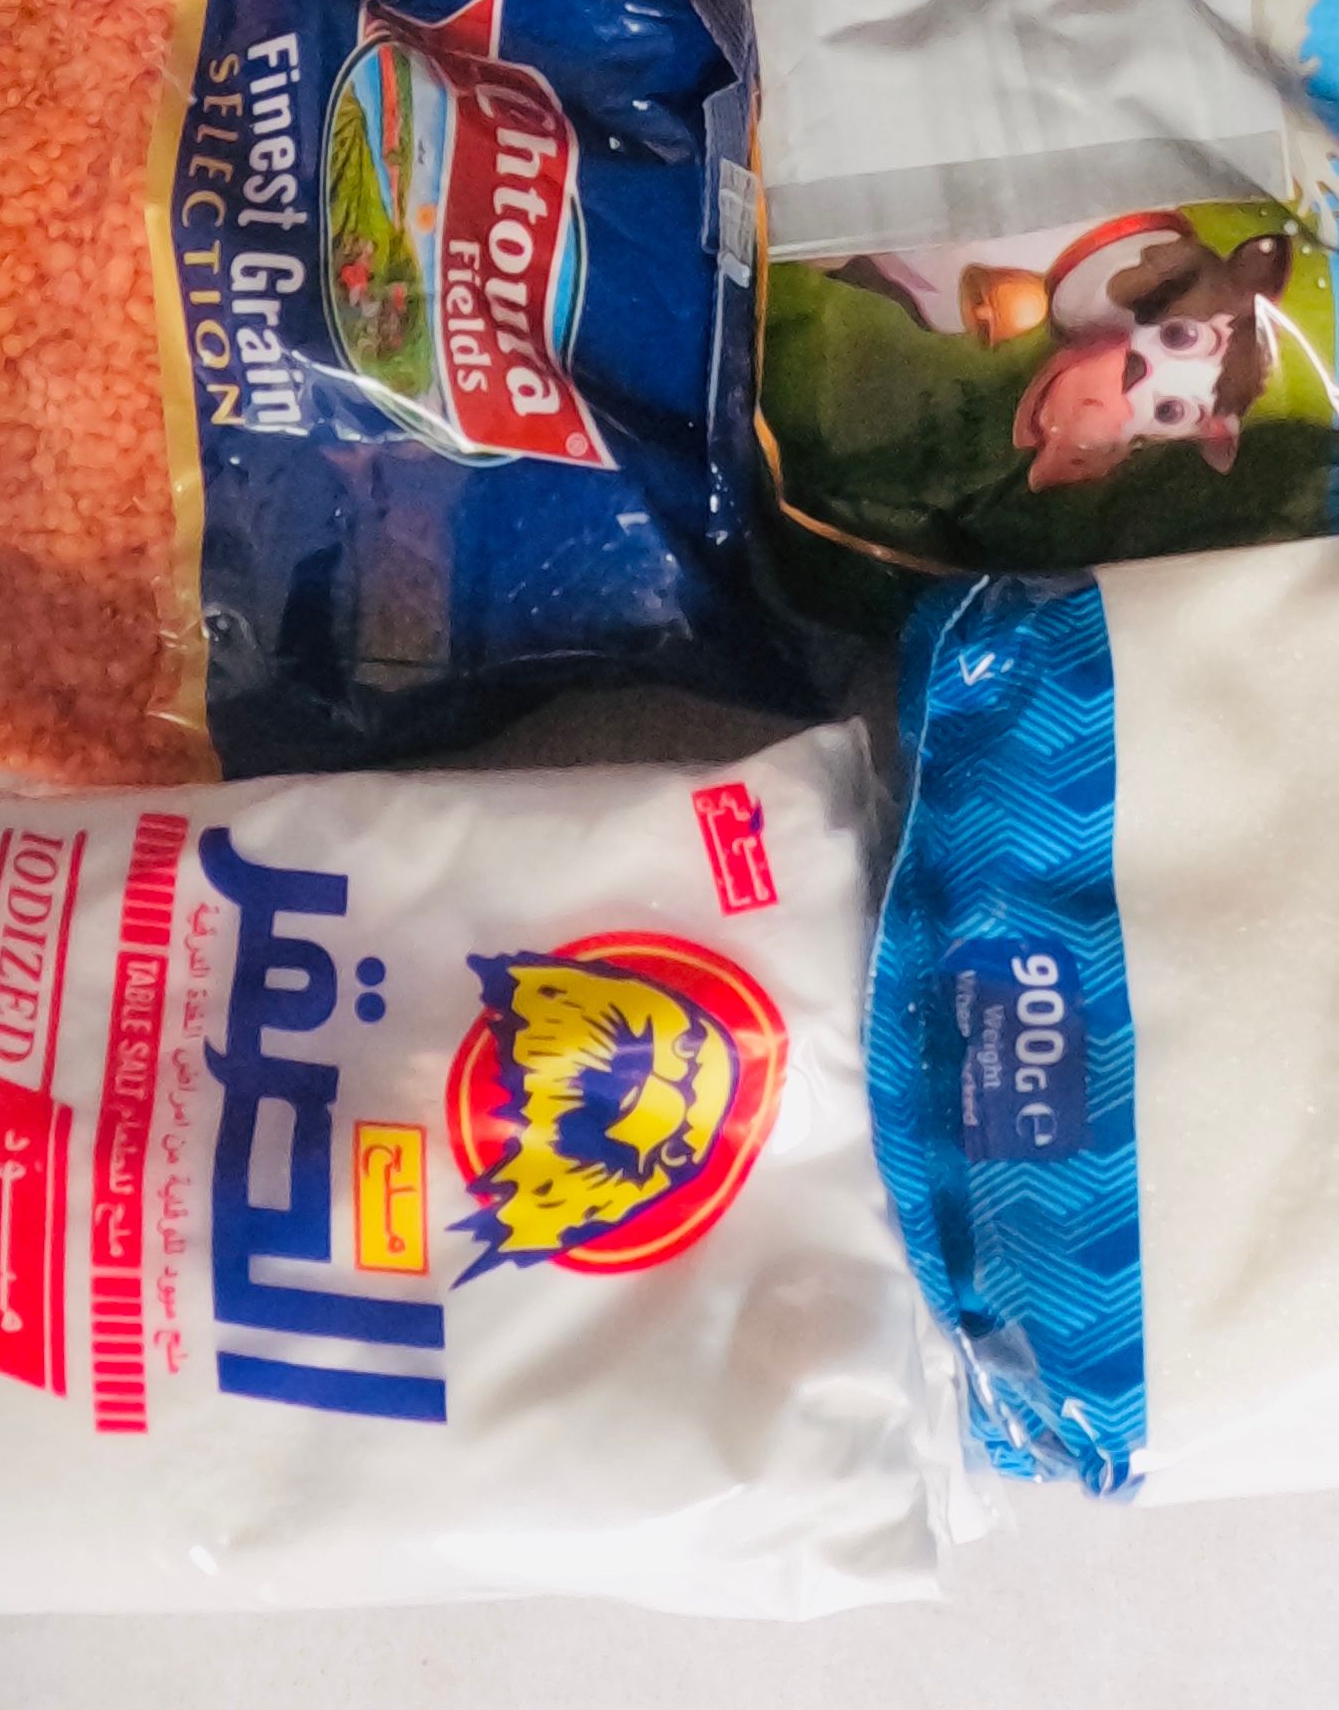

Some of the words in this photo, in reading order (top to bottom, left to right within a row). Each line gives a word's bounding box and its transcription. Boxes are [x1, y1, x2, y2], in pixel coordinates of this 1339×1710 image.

[239, 30, 302, 232] Finest
[179, 50, 246, 428] SELECTION
[445, 236, 492, 396] Fields
[476, 85, 574, 420] Chtoura
[229, 254, 308, 438] Grain
[115, 1038, 150, 1099] SALT
[125, 957, 160, 1034] TABLE
[976, 1004, 1006, 1090] Weight
[95, 1201, 127, 1259] ملح
